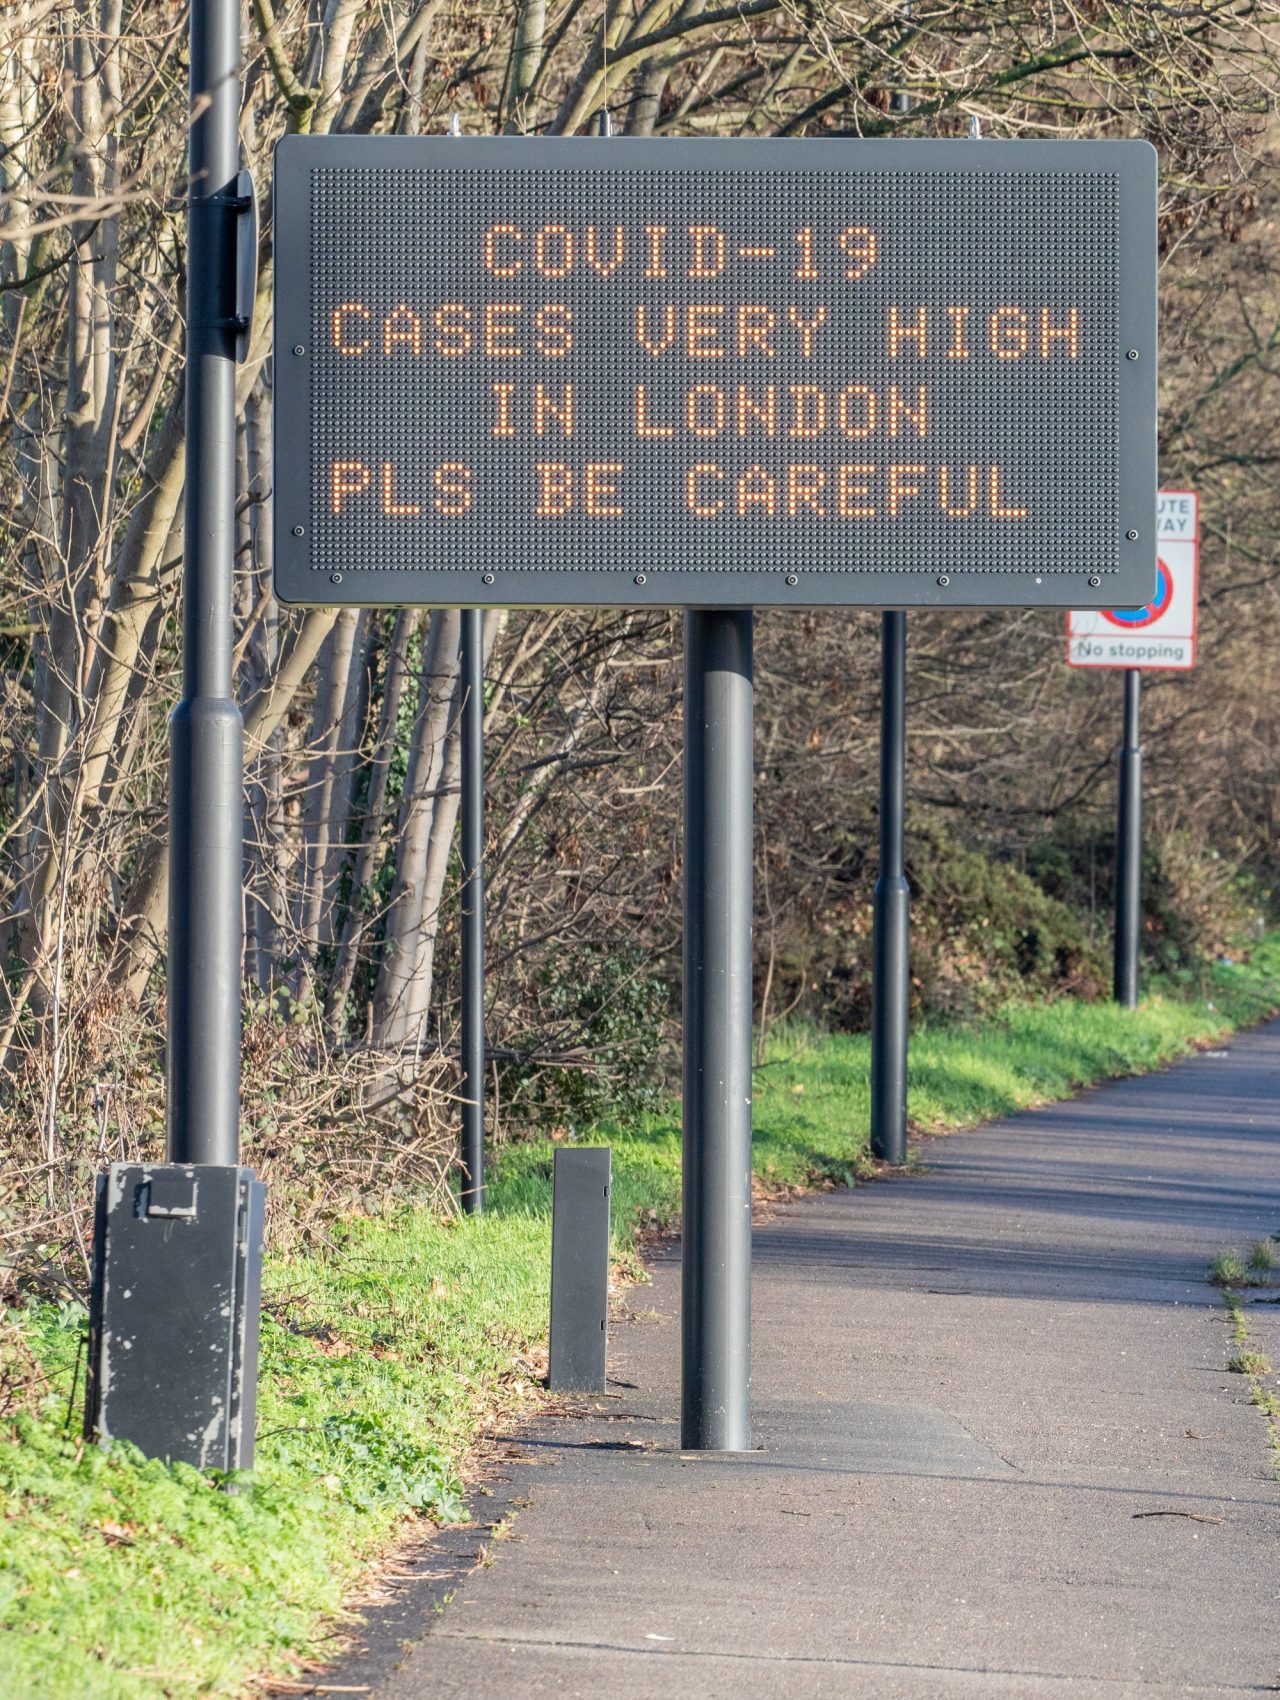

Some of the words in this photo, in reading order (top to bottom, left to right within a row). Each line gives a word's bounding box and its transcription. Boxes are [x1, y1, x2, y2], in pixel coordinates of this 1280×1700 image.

[484, 224, 878, 279] COVID-19
[332, 302, 573, 357] CASES
[636, 304, 826, 358] VERY
[888, 306, 1080, 360] HIGH
[490, 383, 574, 437] IN
[636, 383, 929, 438] LONDON
[332, 462, 474, 517] PLS
[537, 462, 624, 516] BE
[686, 463, 1029, 518] CAREFUL
[1077, 640, 1104, 657] No
[1109, 642, 1184, 661] stopping
